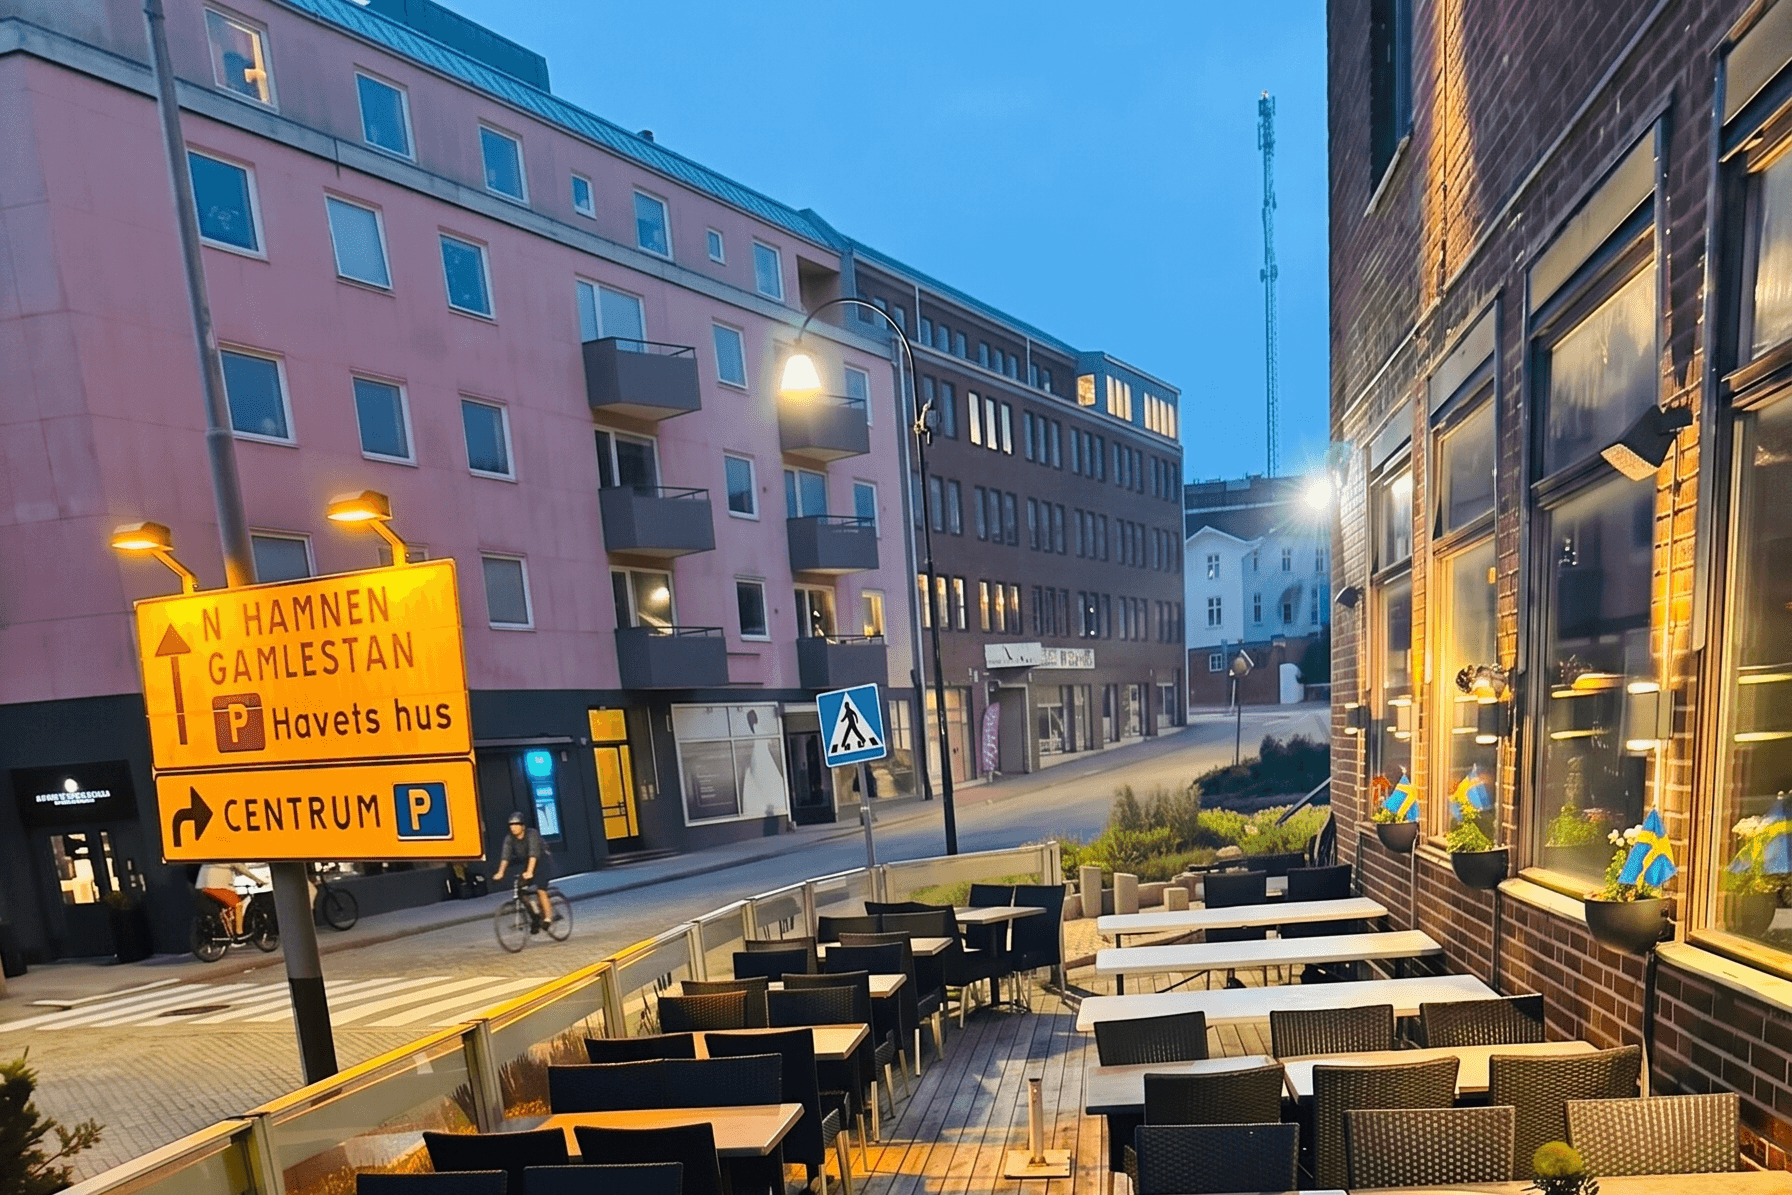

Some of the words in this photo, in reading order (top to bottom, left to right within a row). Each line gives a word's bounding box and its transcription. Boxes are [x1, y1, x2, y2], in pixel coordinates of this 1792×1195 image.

[203, 606, 222, 642] N
[243, 586, 389, 637] HAMNEN
[208, 631, 414, 685] GAMLESTAN
[228, 703, 249, 743] P
[272, 703, 380, 740] Havets
[394, 698, 452, 732] hus
[223, 795, 381, 832] CENTRUM
[408, 788, 431, 831] P
